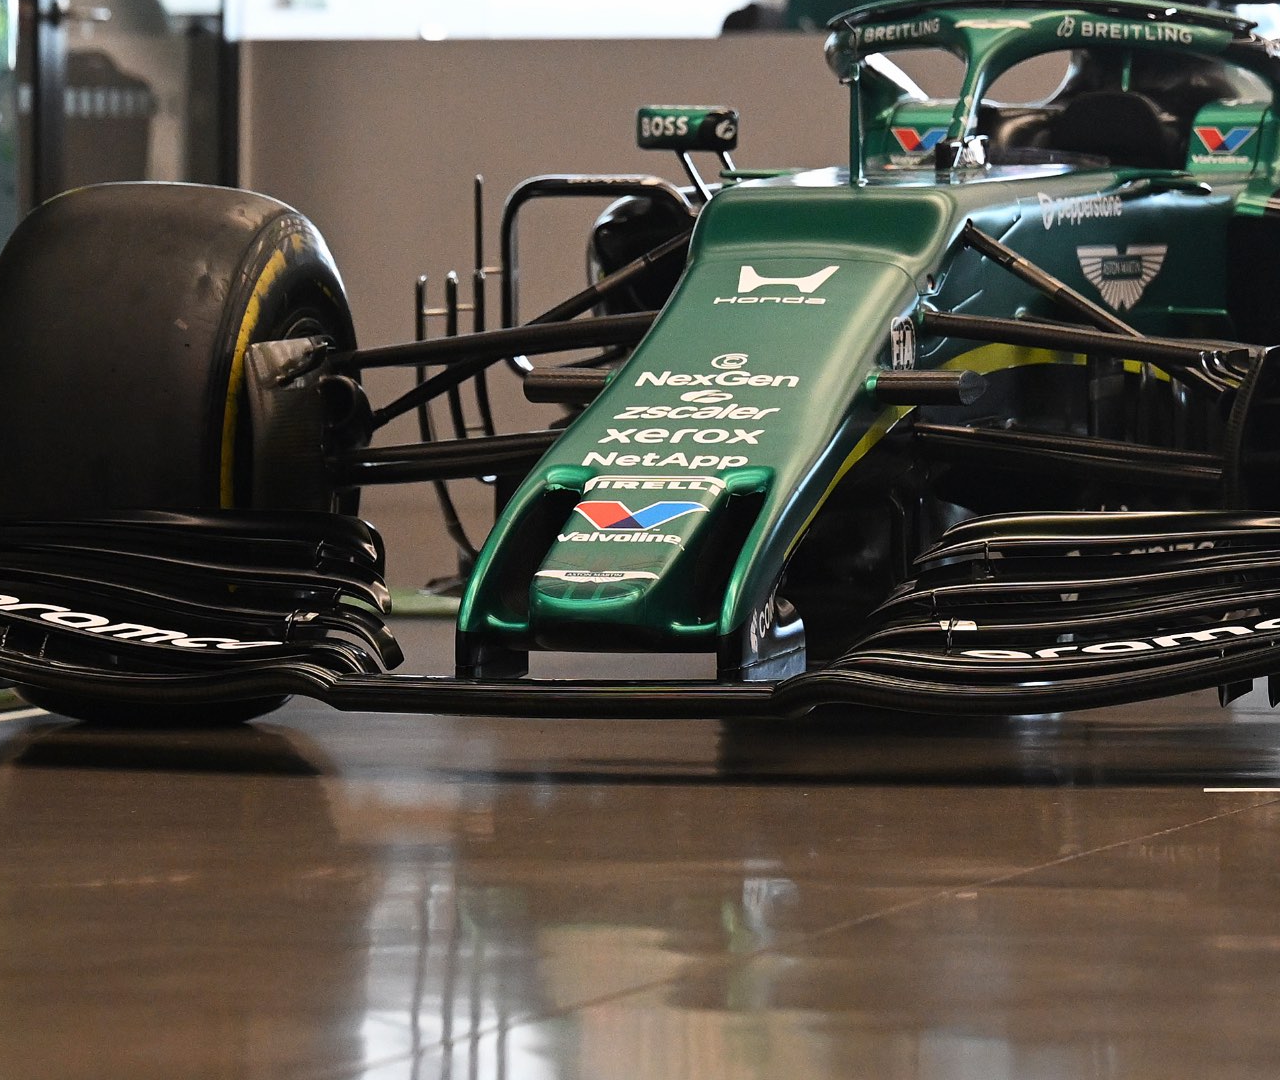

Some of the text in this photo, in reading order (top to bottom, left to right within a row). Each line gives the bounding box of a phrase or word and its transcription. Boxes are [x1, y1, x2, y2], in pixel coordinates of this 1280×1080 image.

[863, 18, 941, 43] BREITLING
[1080, 21, 1193, 44] BREITLING
[641, 115, 689, 138] BOSS
[1055, 190, 1122, 226] pepperstone
[713, 296, 827, 305] Honda
[634, 370, 800, 387] NexGen
[613, 403, 782, 420] zscaler
[598, 428, 766, 445] xerox
[581, 451, 749, 470] NetApp
[583, 475, 726, 497] PIRELLI
[557, 531, 682, 546] Valvoline
